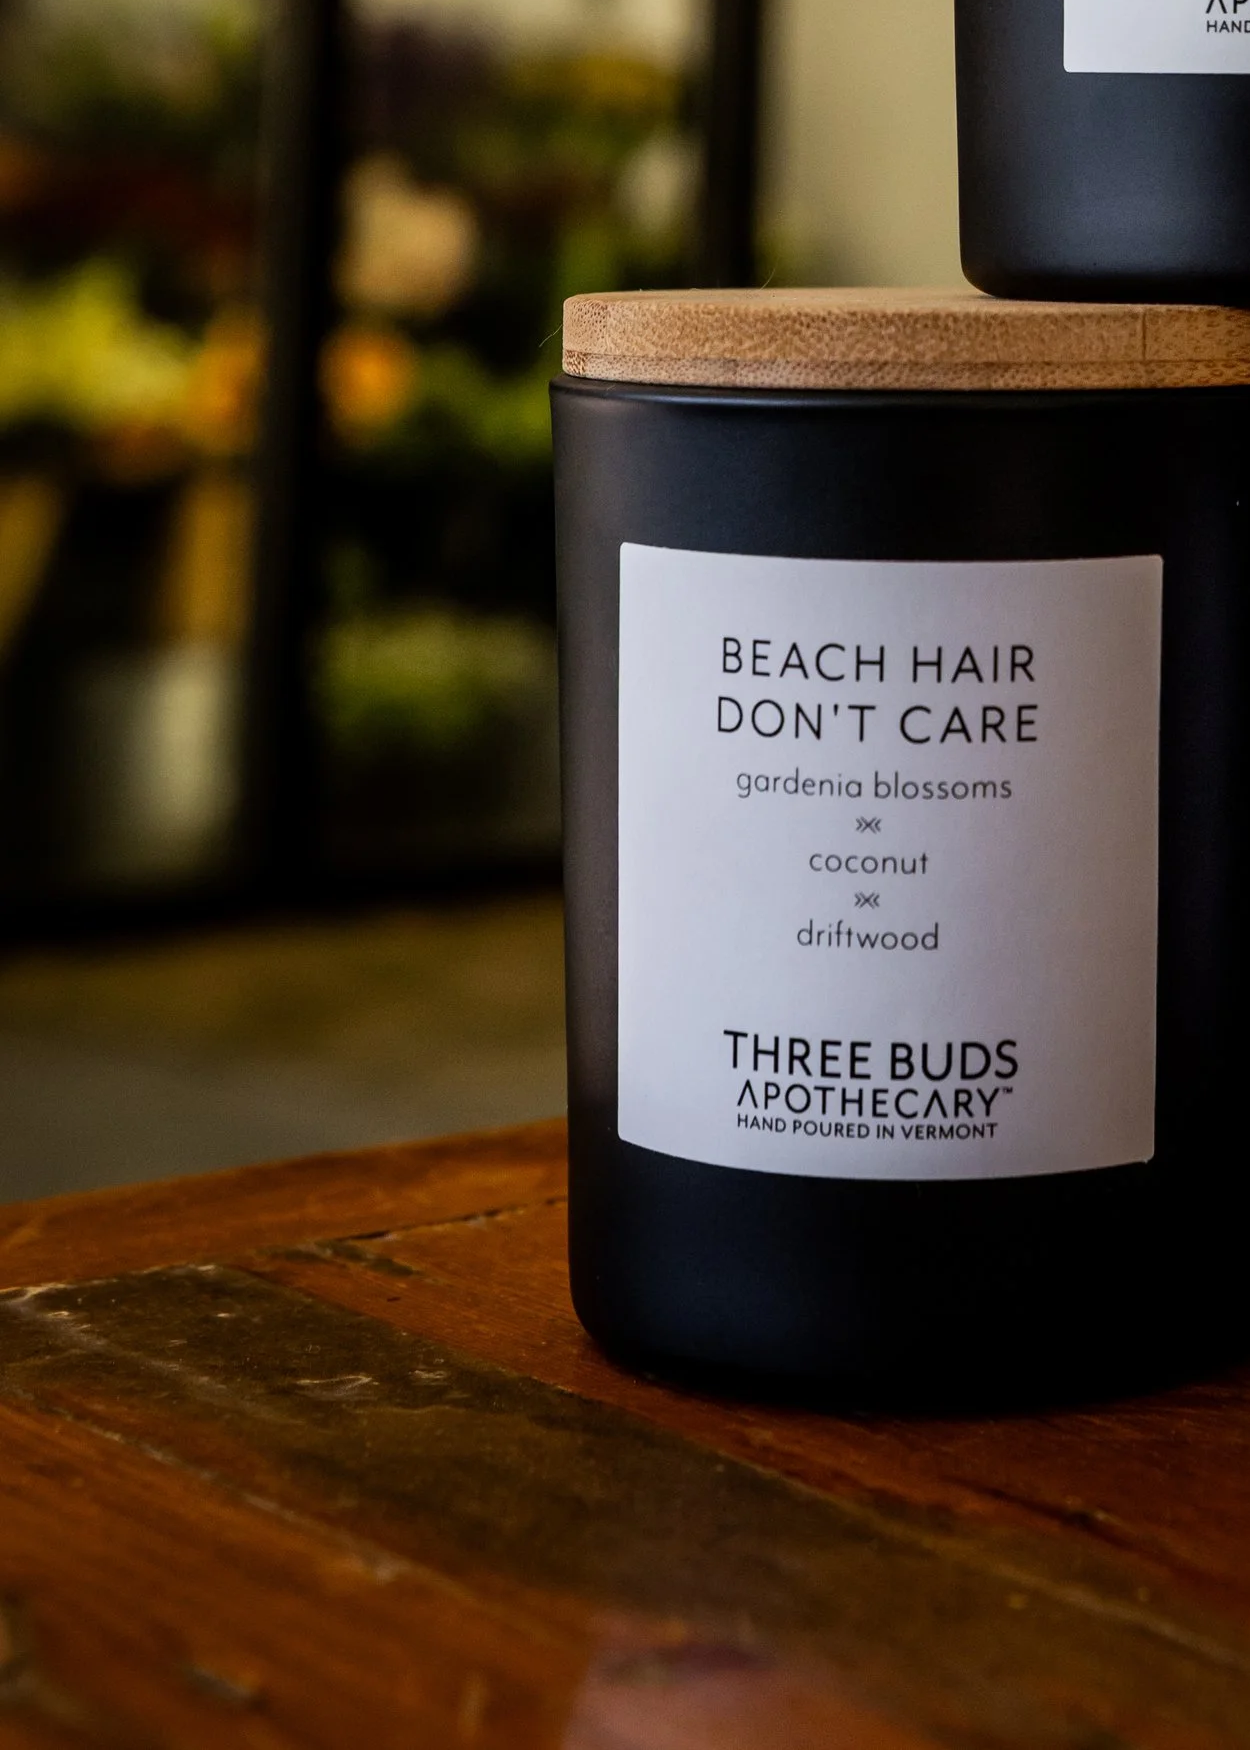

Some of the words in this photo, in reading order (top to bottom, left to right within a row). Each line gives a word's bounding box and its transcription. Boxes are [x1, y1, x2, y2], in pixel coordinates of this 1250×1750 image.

[722, 637, 885, 682] BEACH
[912, 646, 1036, 684] HAIR
[718, 696, 877, 742] DON'T
[900, 704, 1038, 744] CARE
[736, 769, 862, 798] gardenia
[874, 771, 1012, 800] blossoms
[809, 852, 928, 874] coconut
[797, 920, 939, 951] driftwood
[724, 1030, 872, 1078] THREE
[890, 1039, 1018, 1080] BUDS
[737, 1114, 786, 1132] HAND
[793, 1120, 870, 1139] POURED
[876, 1125, 894, 1139] IN
[901, 1123, 998, 1140] VERMONT
